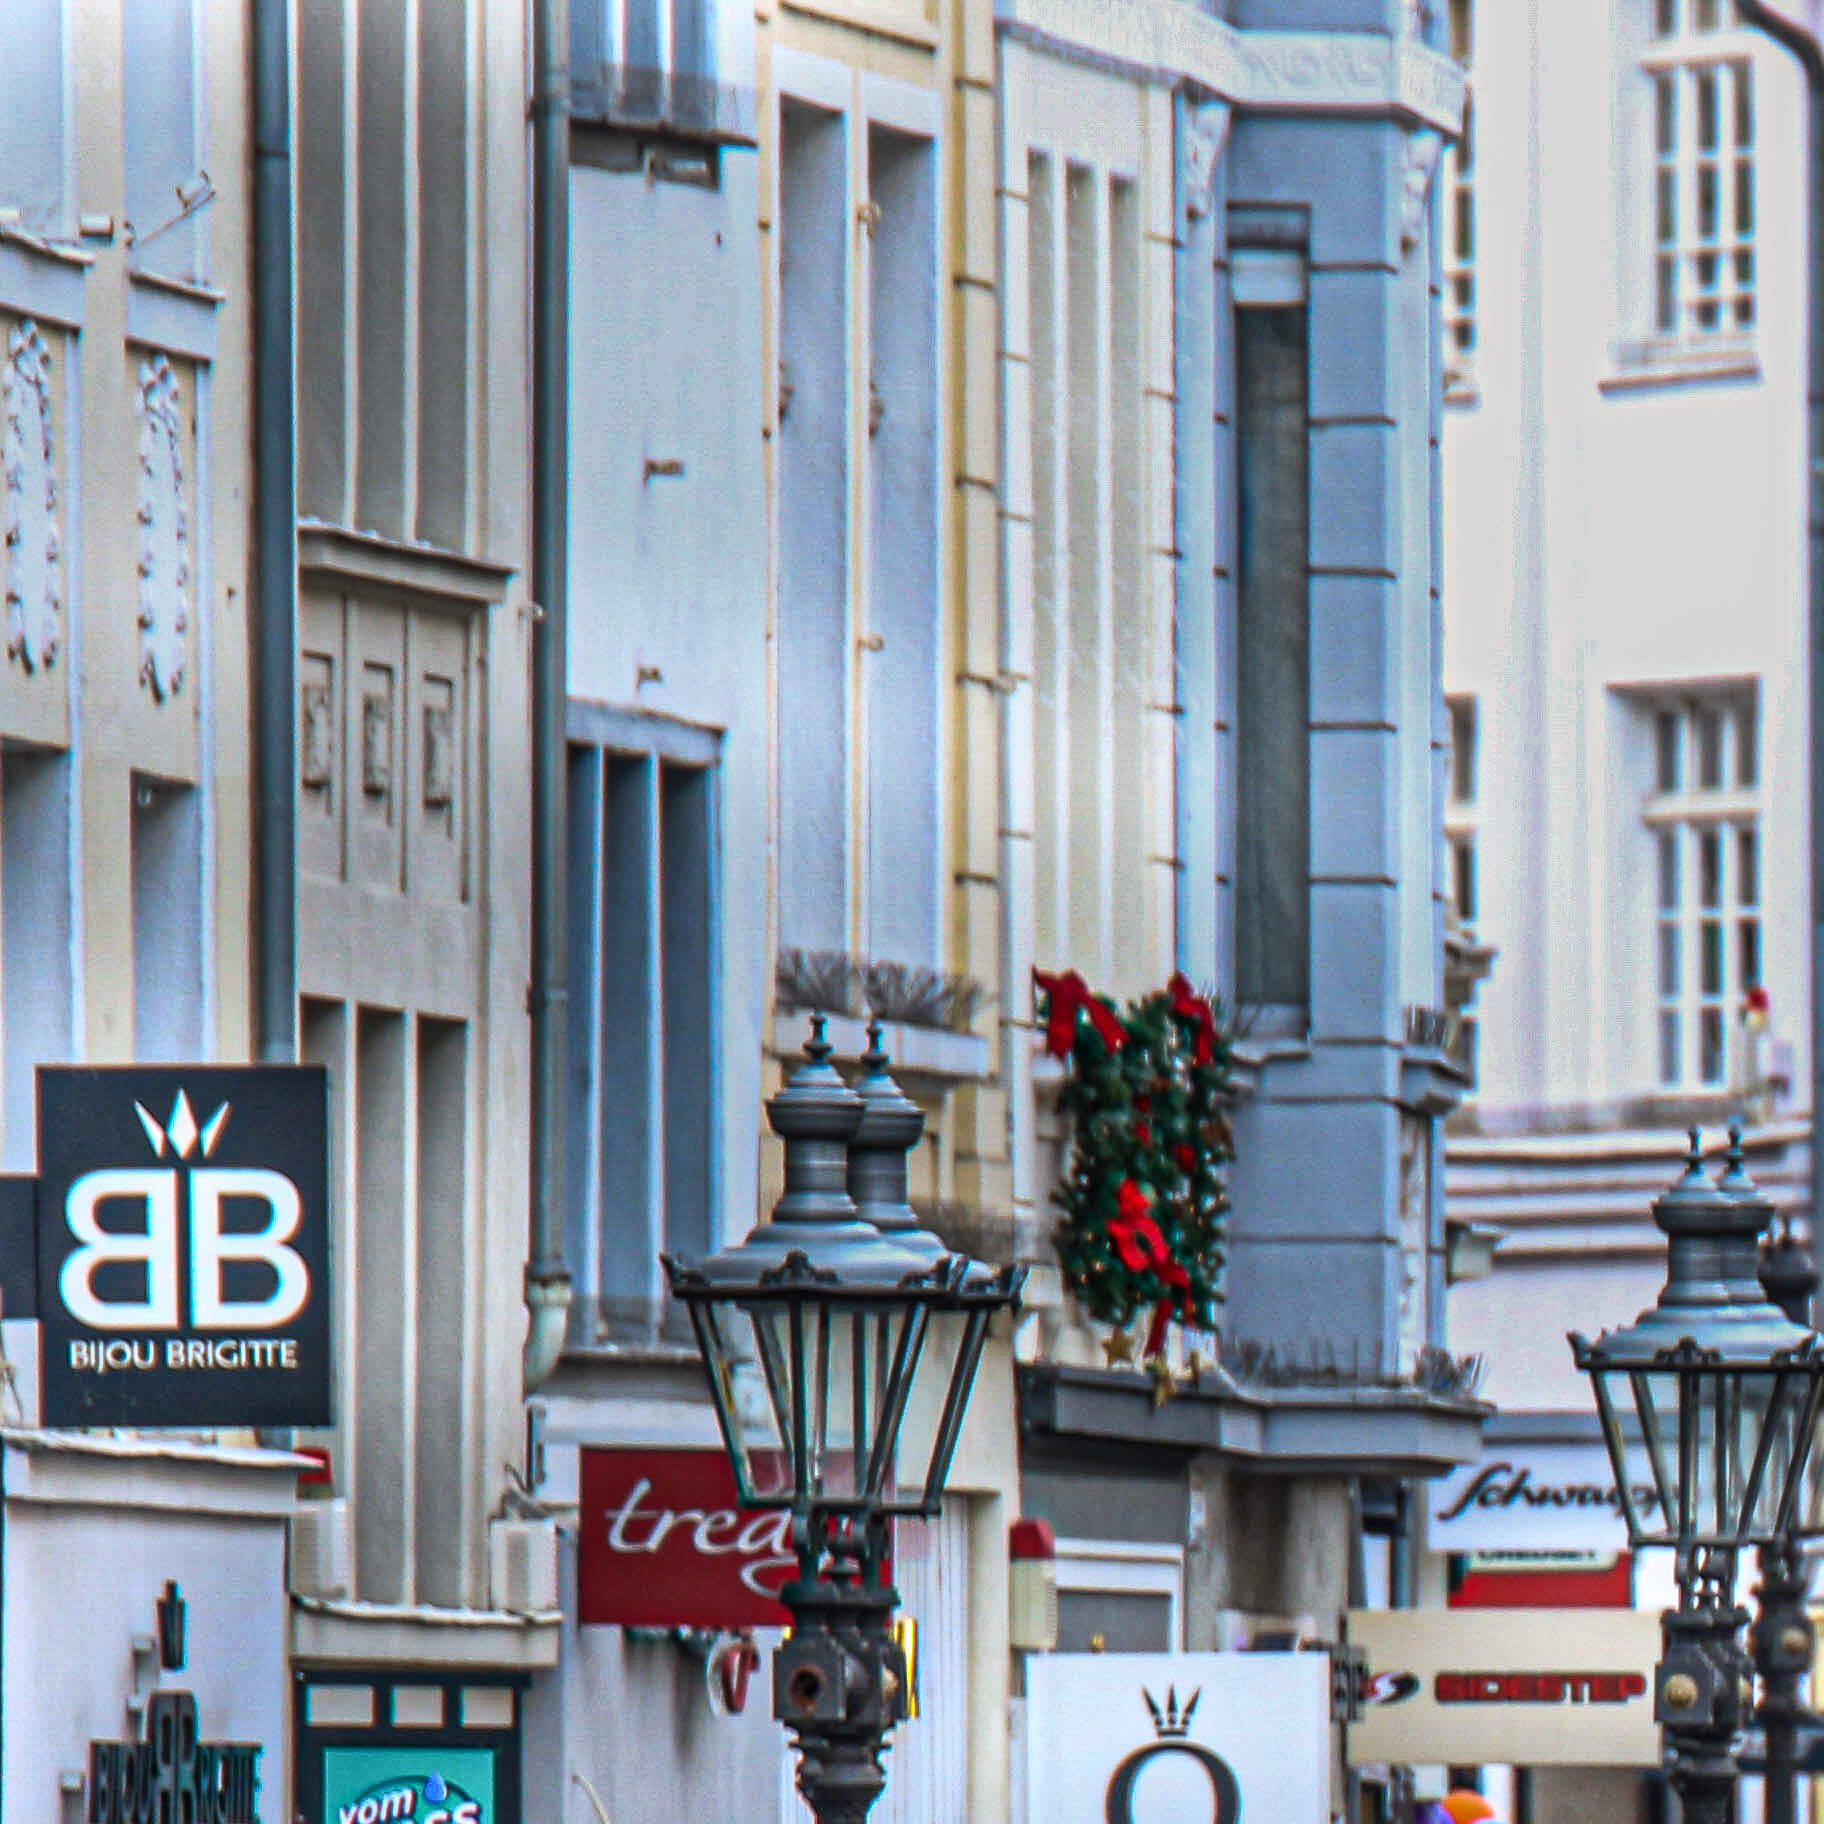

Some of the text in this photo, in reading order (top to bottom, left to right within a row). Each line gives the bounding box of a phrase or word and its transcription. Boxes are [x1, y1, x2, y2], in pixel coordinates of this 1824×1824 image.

[70, 1339, 299, 1371] BIJOU BRIGITTE
[1434, 1672, 1646, 1704] SIDESTEP
